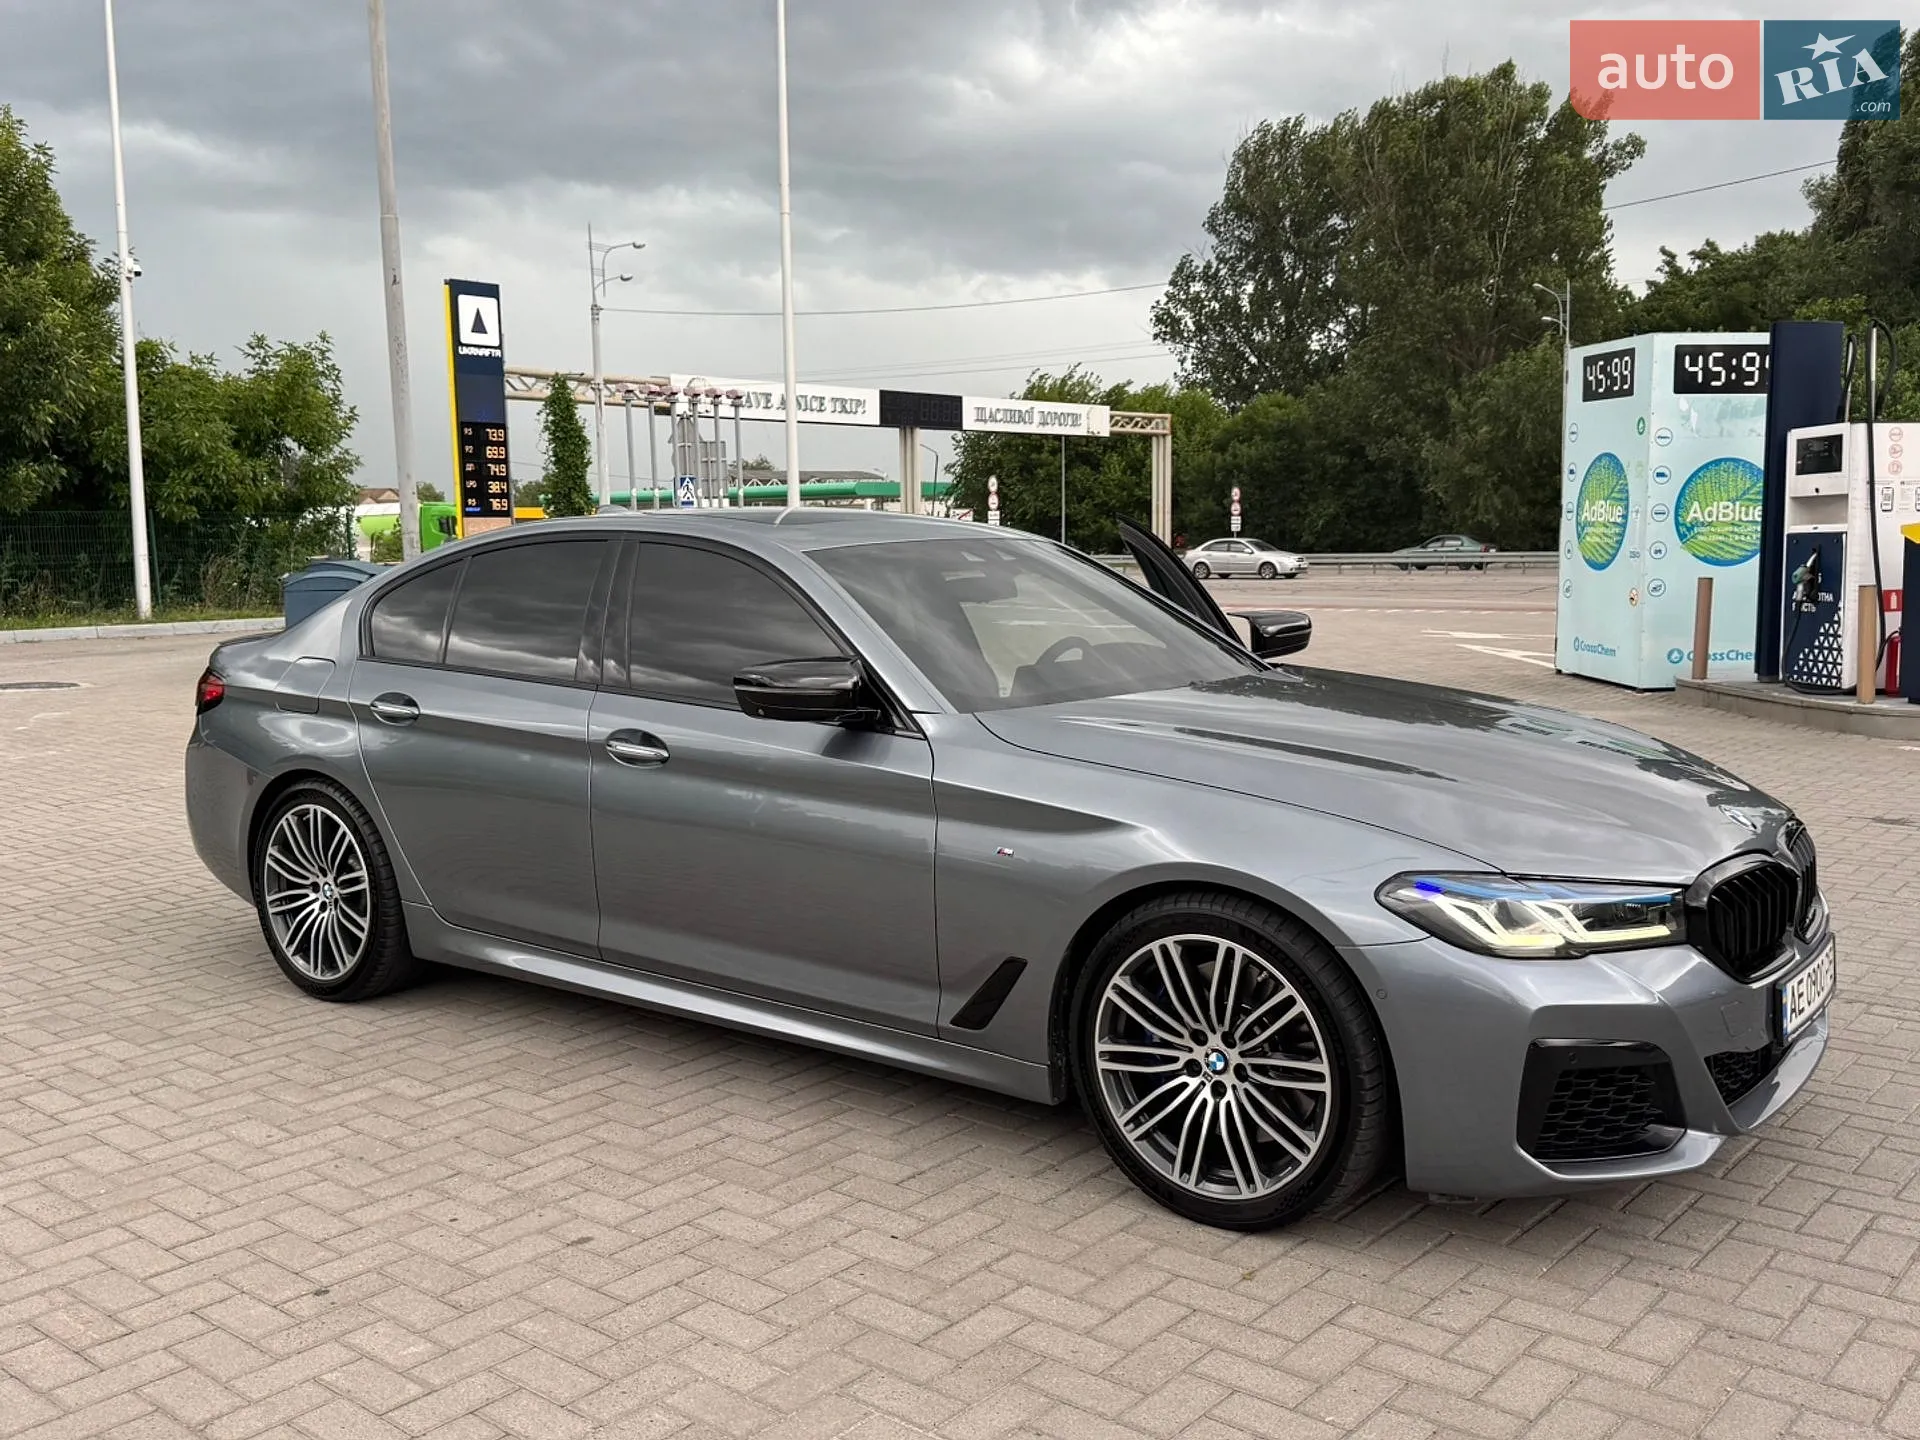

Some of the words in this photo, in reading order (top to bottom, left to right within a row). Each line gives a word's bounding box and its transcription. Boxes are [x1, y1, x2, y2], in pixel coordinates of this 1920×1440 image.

[1586, 355, 1632, 393] 45:99
[1684, 351, 1770, 387] 45:9
[739, 391, 774, 410] AVE
[1581, 499, 1624, 523] AdBlue
[1686, 500, 1763, 523] AdBlue
